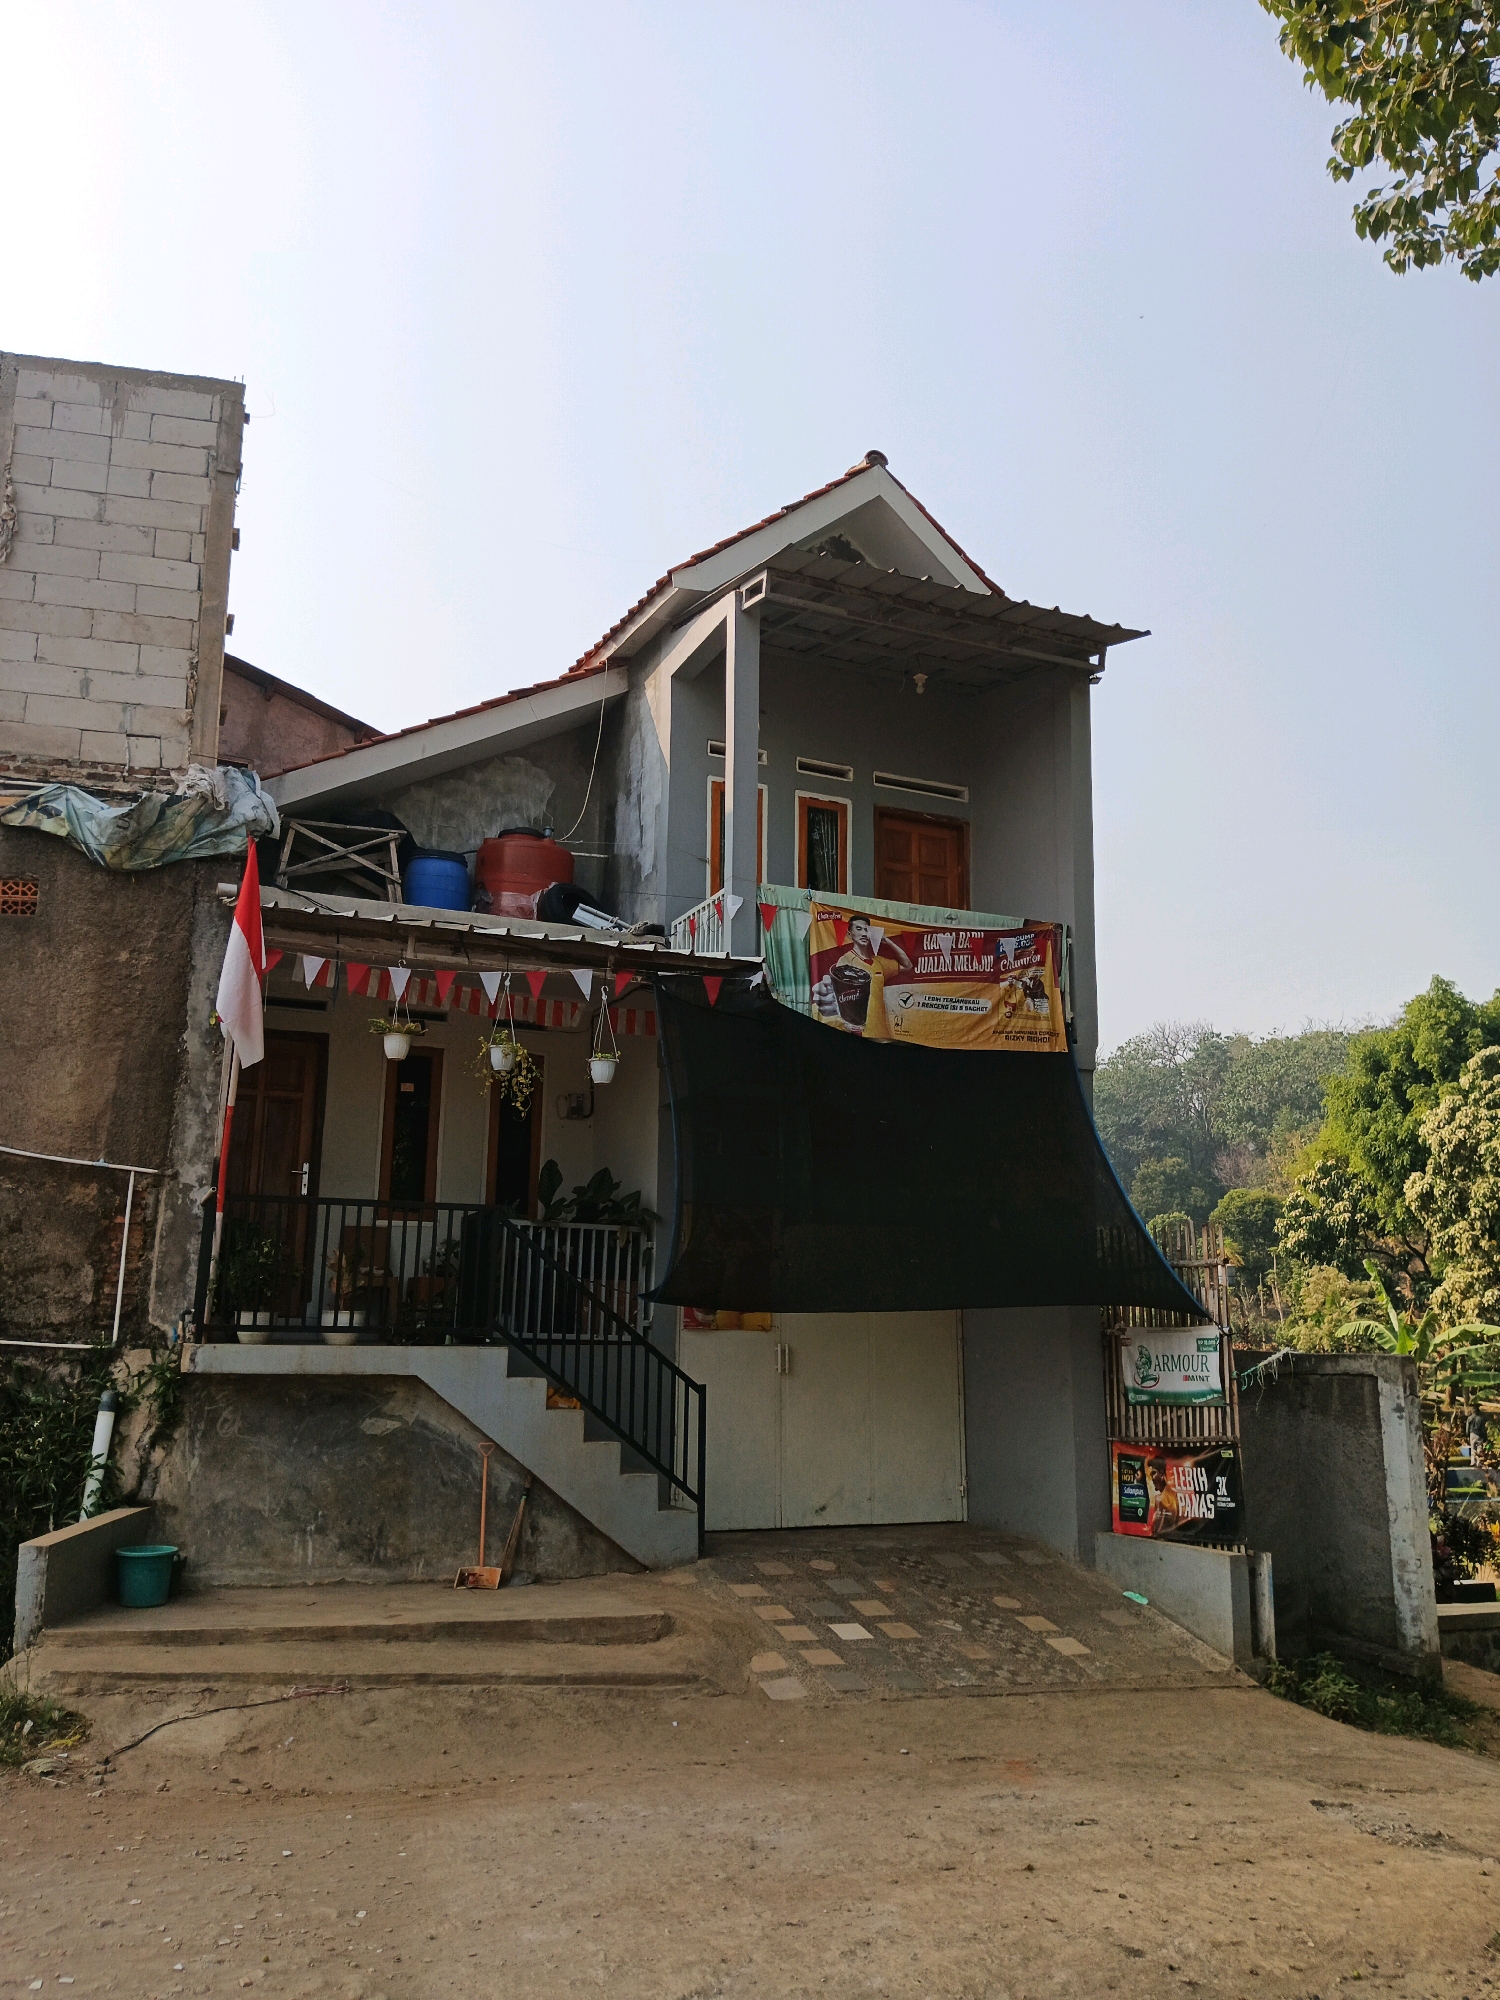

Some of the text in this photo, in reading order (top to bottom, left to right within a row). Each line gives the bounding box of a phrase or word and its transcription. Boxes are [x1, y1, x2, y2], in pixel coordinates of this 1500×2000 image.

[923, 932, 956, 950] HAA
[914, 955, 994, 974] JUALAN MELAJU!
[1004, 1034, 1025, 1042] RIZKY
[1154, 1354, 1210, 1373] ARMOUR
[1173, 1466, 1209, 1492] LEBIH
[1215, 1476, 1228, 1496] 3X
[1176, 1493, 1215, 1520] PANAS
